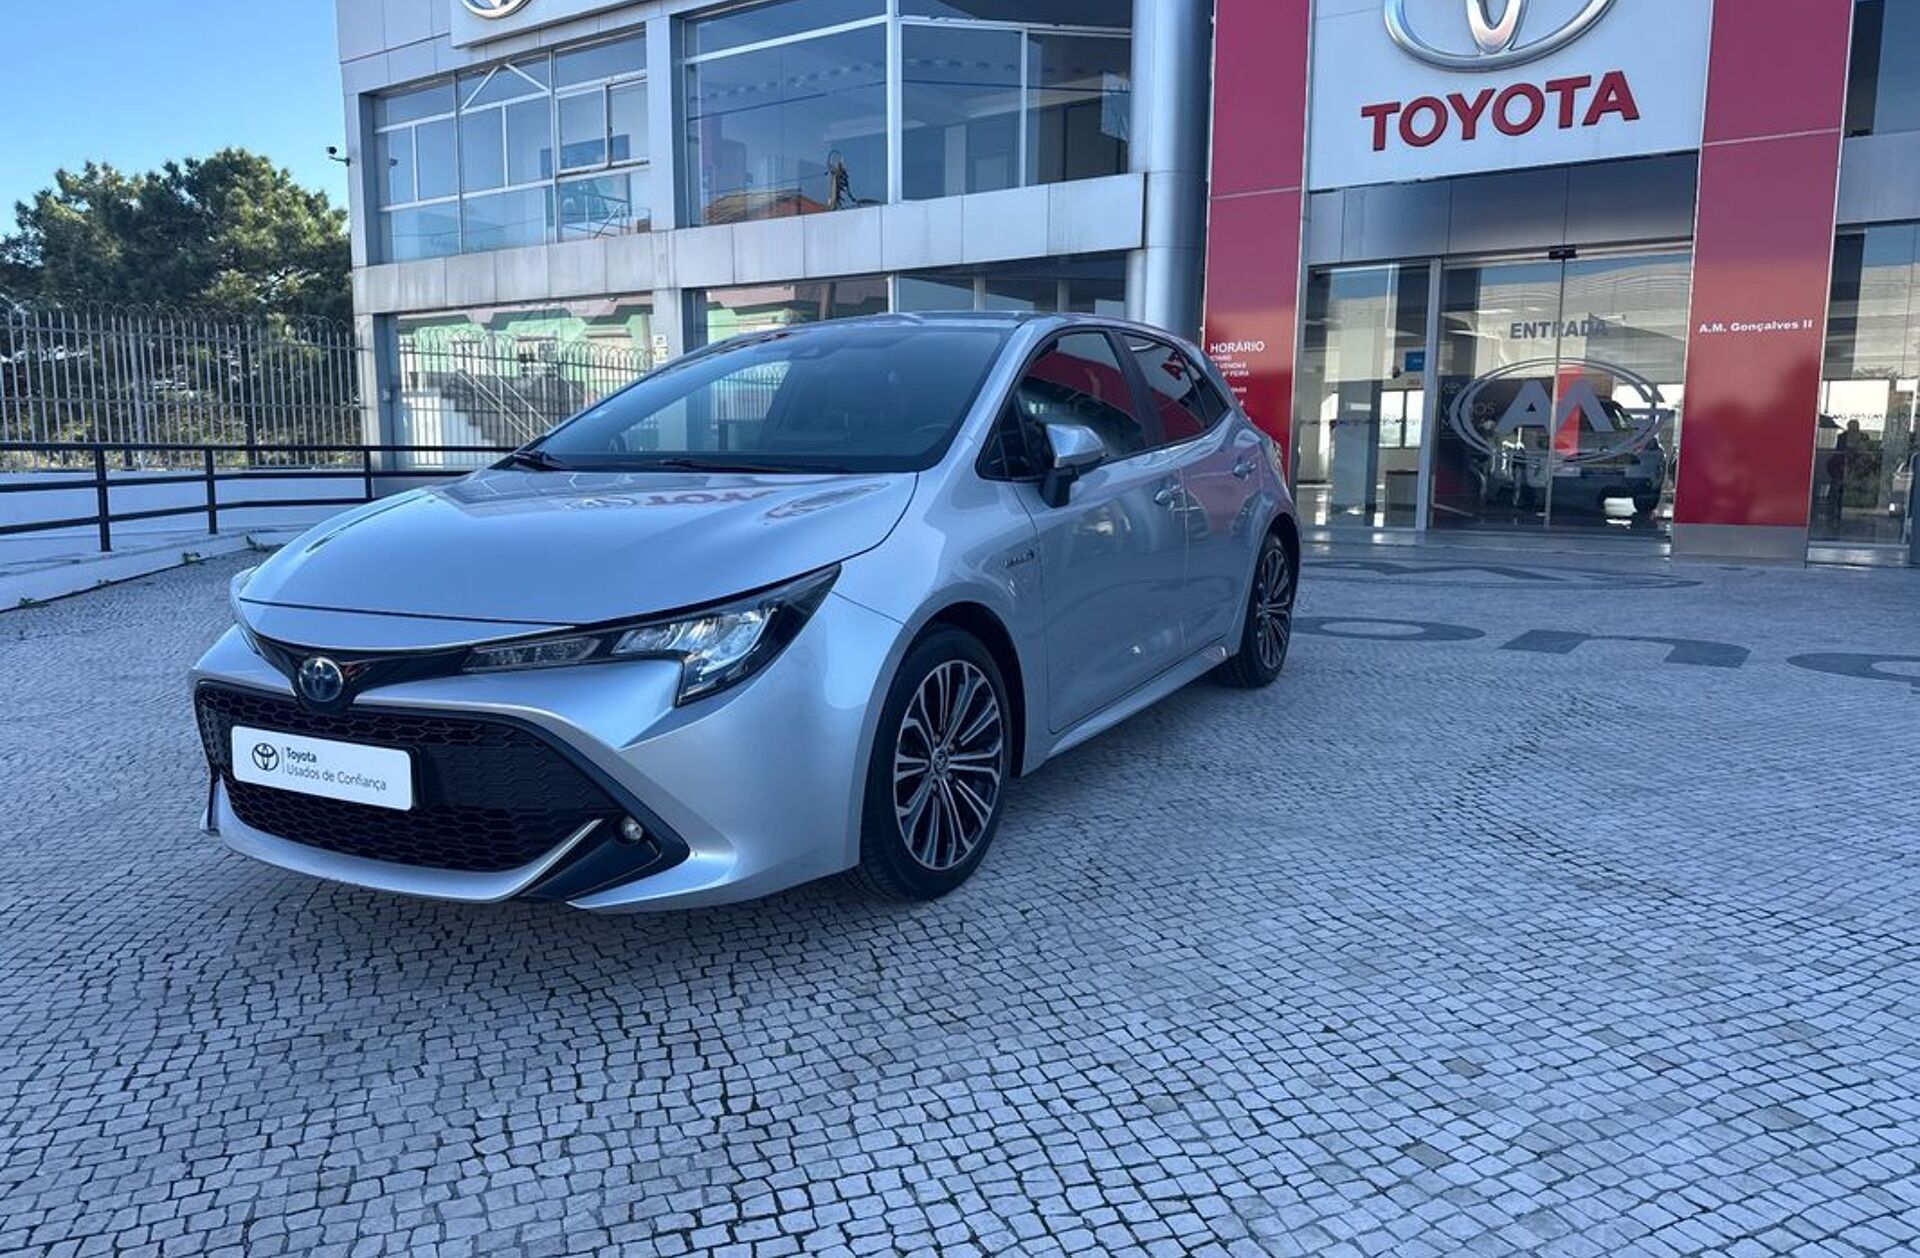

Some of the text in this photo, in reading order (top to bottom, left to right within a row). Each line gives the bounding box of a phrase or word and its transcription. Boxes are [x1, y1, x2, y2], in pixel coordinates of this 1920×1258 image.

[1361, 70, 1640, 151] TOYOTA
[1510, 320, 1608, 339] ENTRADA
[1699, 323, 1727, 333] A.M.
[1730, 320, 1799, 332] Gonçalves
[1210, 340, 1265, 353] HORÁRIO
[286, 746, 317, 763] Toyota
[286, 764, 387, 791] Usados de Confiança
